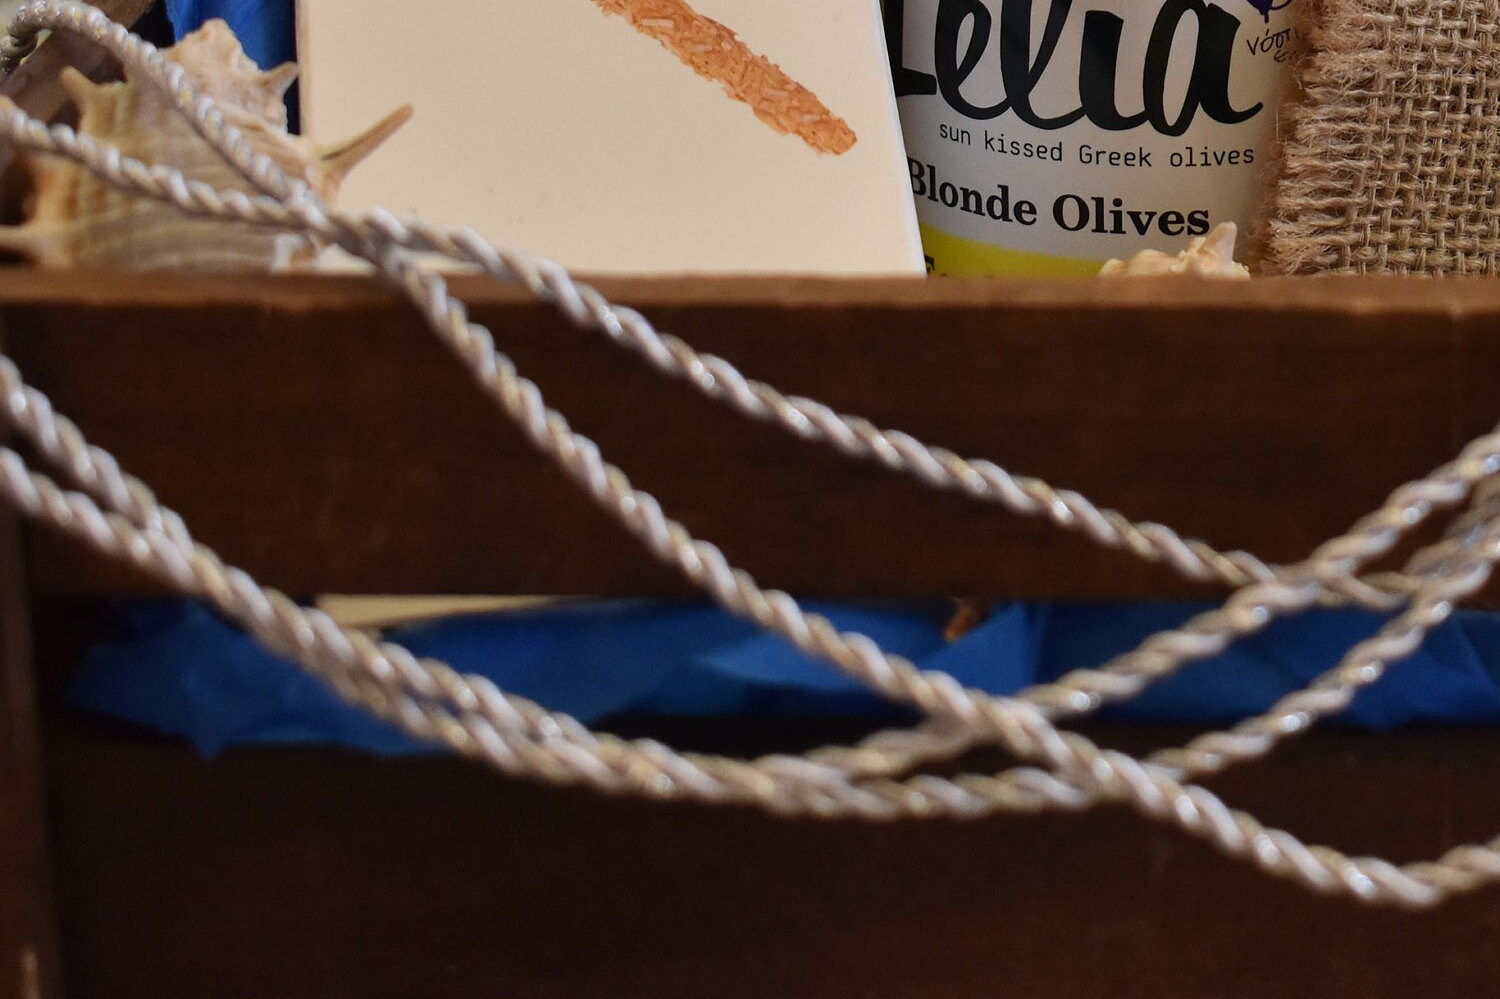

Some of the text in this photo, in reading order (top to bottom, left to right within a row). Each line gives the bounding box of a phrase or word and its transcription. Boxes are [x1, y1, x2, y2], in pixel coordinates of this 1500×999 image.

[940, 122, 1255, 168] sun kissed Greek olives
[909, 156, 1211, 237] Blonde Olives
